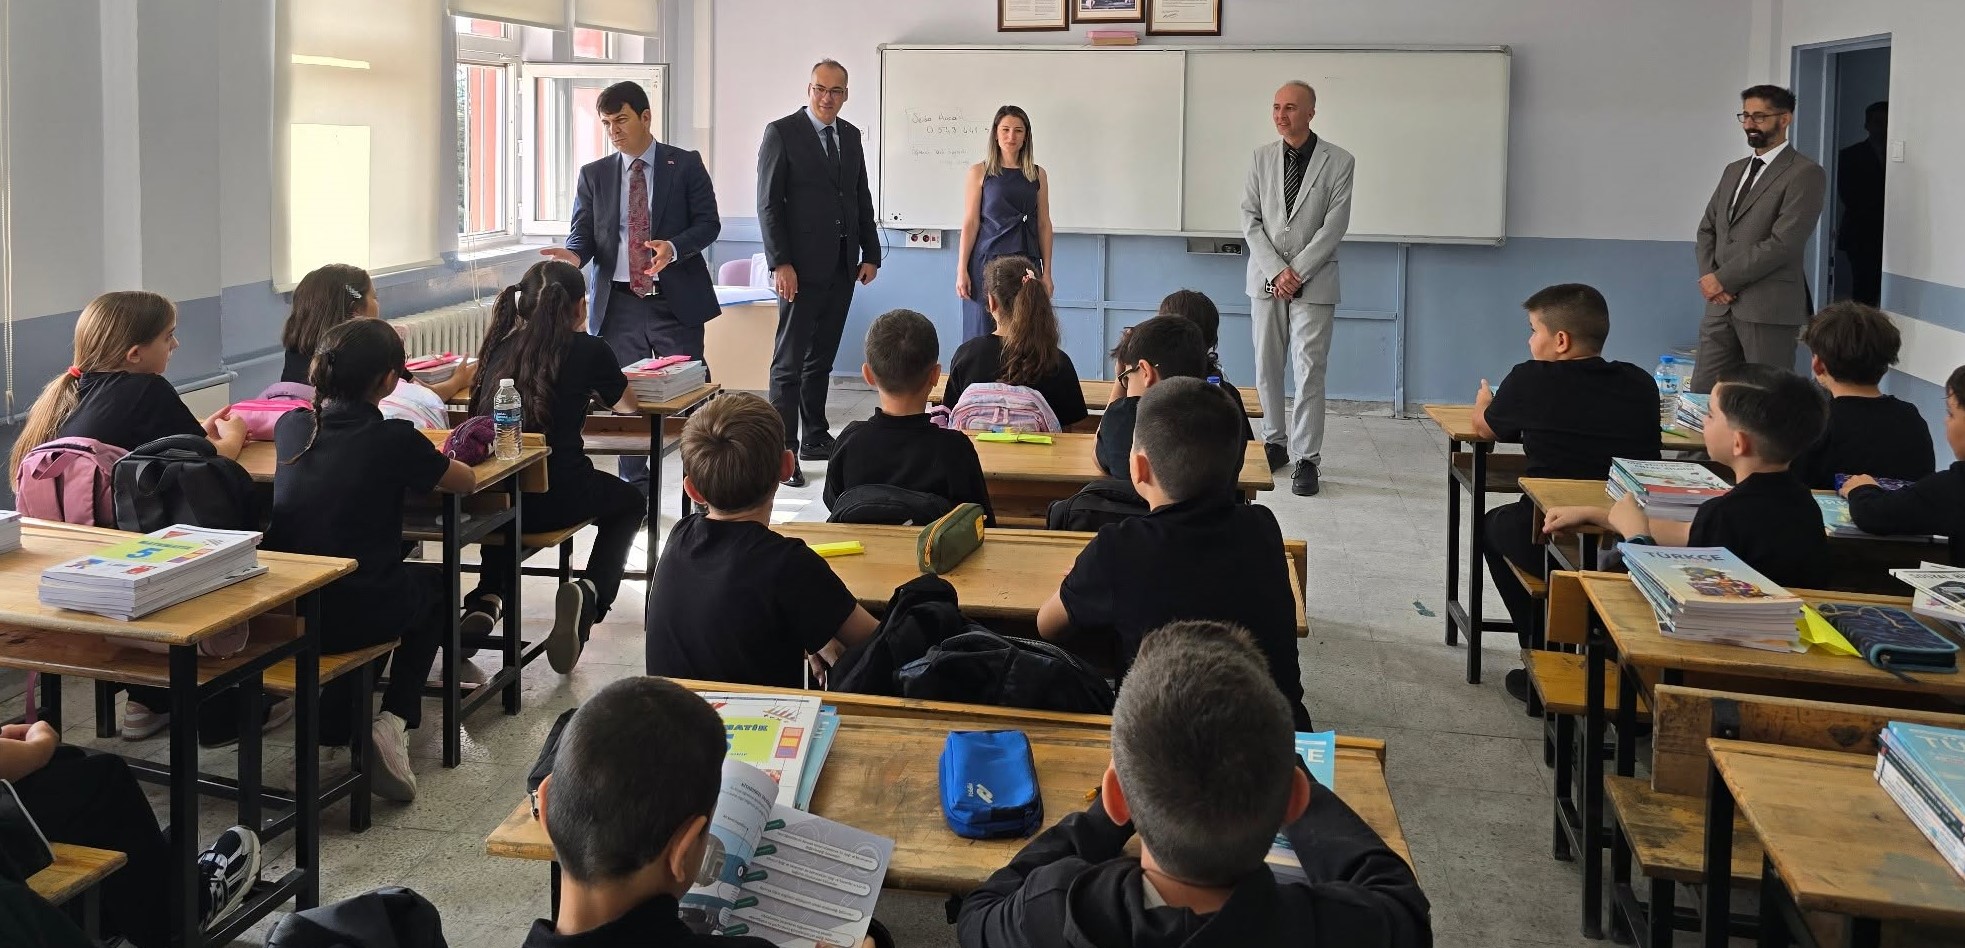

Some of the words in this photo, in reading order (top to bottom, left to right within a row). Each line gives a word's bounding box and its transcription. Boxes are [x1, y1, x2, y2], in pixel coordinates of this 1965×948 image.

[126, 547, 164, 559] 5
[1643, 551, 1725, 562] TÜRKÇE
[724, 723, 769, 732] MATİK
